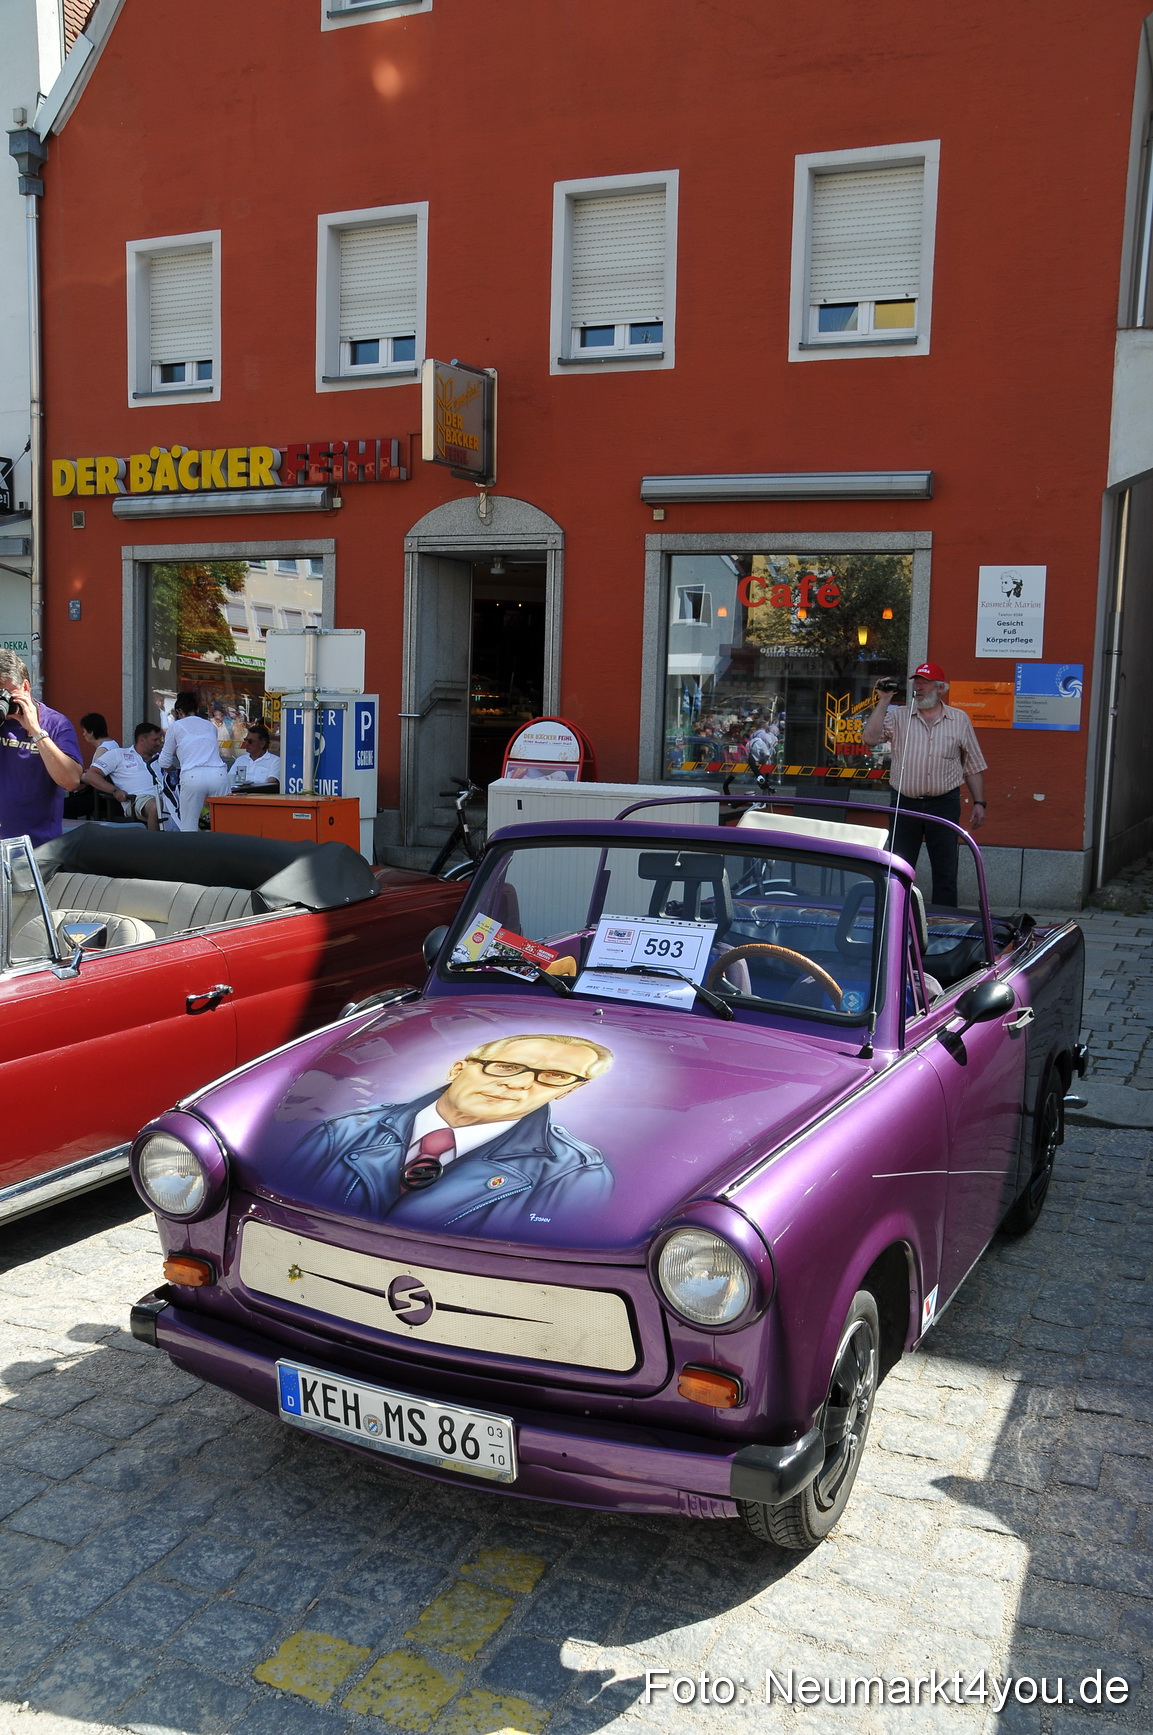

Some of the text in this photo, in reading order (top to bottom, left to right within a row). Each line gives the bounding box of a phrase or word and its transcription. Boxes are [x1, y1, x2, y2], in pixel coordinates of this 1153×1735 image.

[445, 411, 463, 429] DER
[445, 427, 480, 451] BÄCKER
[52, 456, 124, 496] DER
[130, 445, 281, 495] BÄCKER
[737, 575, 841, 608] Café
[981, 599, 1041, 609] Kosmetik Marion
[4, 641, 28, 650] DEKRA
[293, 709, 336, 726] HER
[361, 711, 372, 741] P
[838, 719, 863, 731] DER
[837, 730, 865, 743] BÄC
[357, 750, 374, 766] SCHEINE
[289, 778, 338, 796] SCEINE
[643, 938, 684, 959] 593
[287, 1395, 294, 1407] D
[301, 1377, 480, 1460] KEH MS 86
[487, 1425, 503, 1438] 03
[490, 1453, 505, 1466] 10
